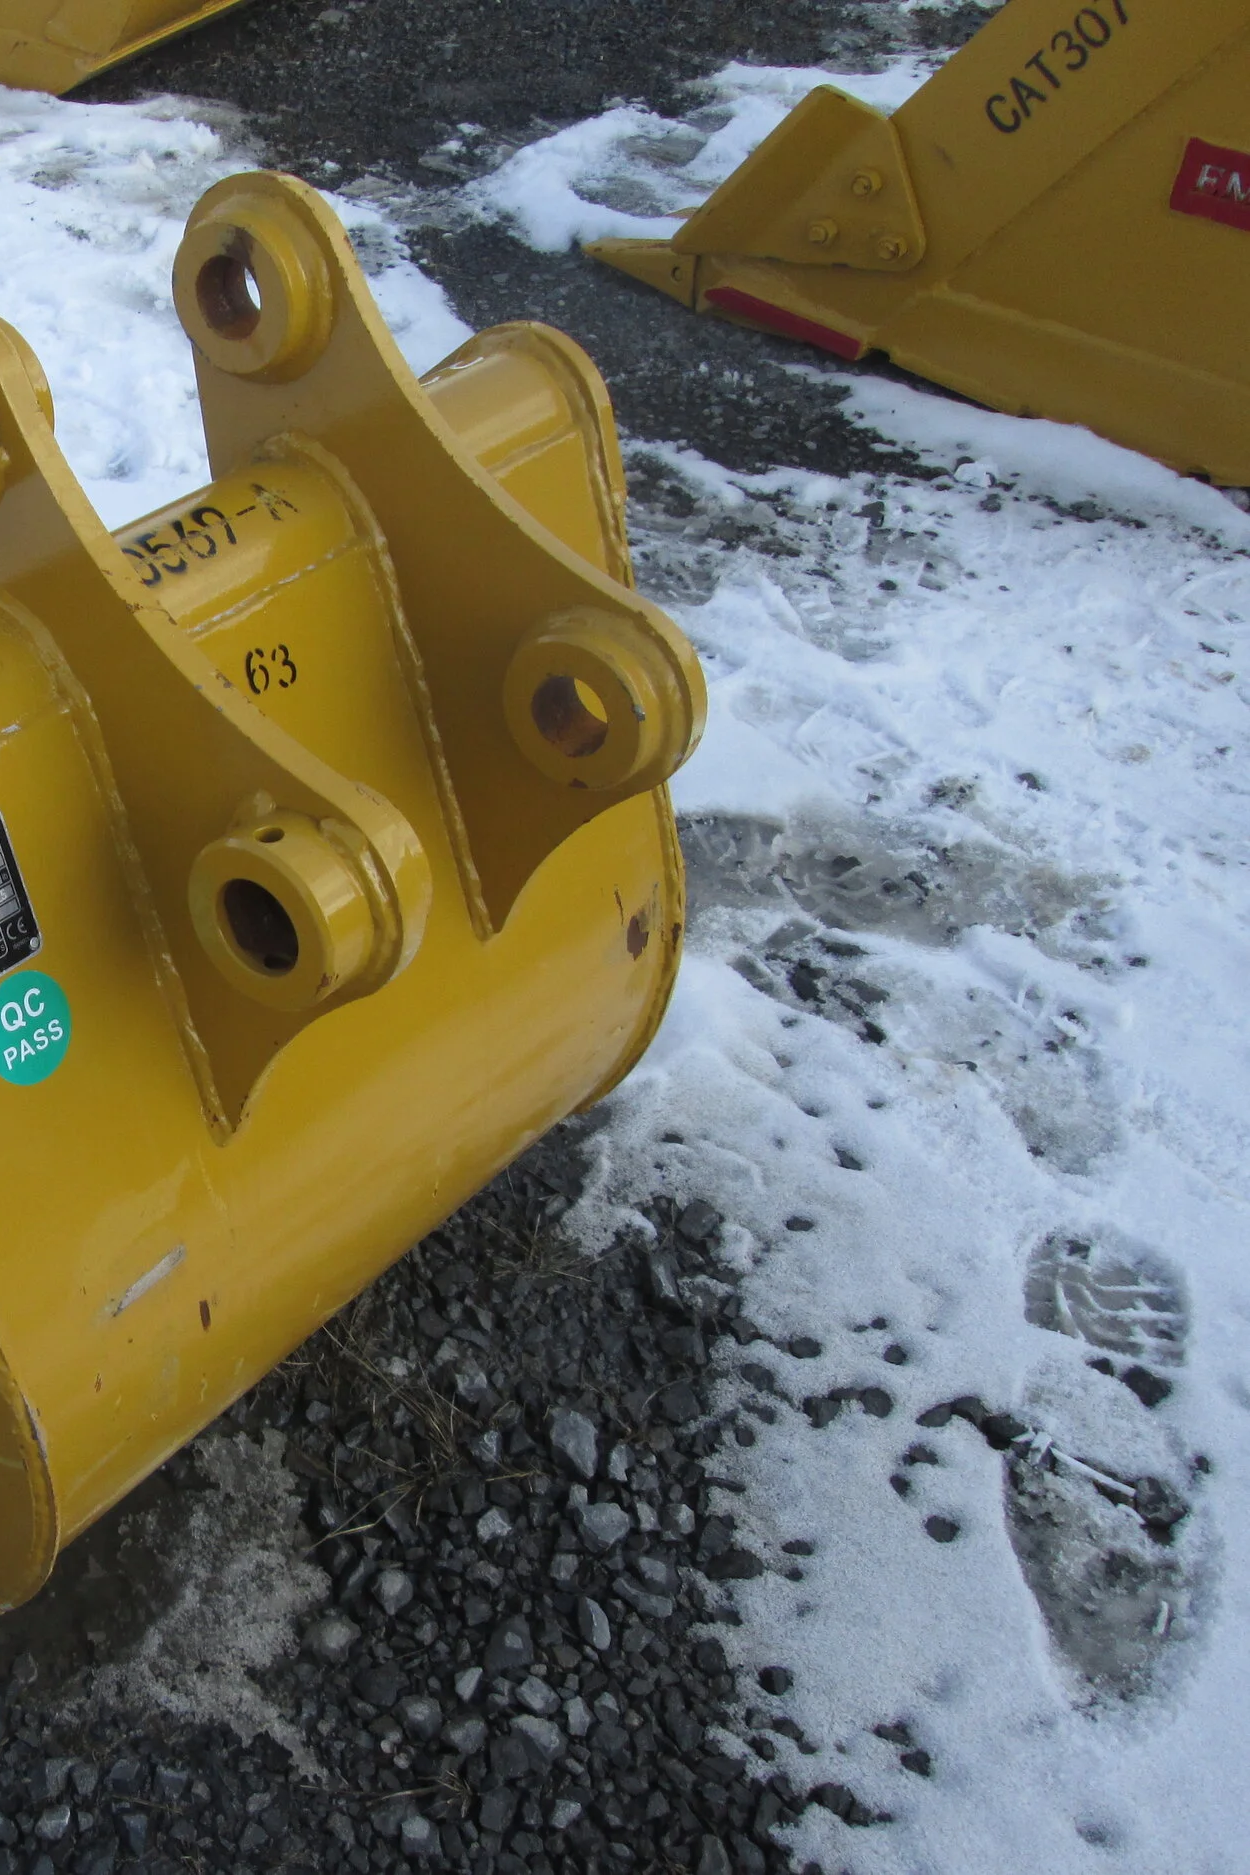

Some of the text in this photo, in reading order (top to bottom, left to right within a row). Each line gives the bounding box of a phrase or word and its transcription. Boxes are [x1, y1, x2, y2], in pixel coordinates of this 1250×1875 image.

[985, 0, 1128, 133] CAT307
[246, 644, 297, 694] 63
[0, 987, 45, 1032] QC
[3, 1018, 64, 1071] PASS
